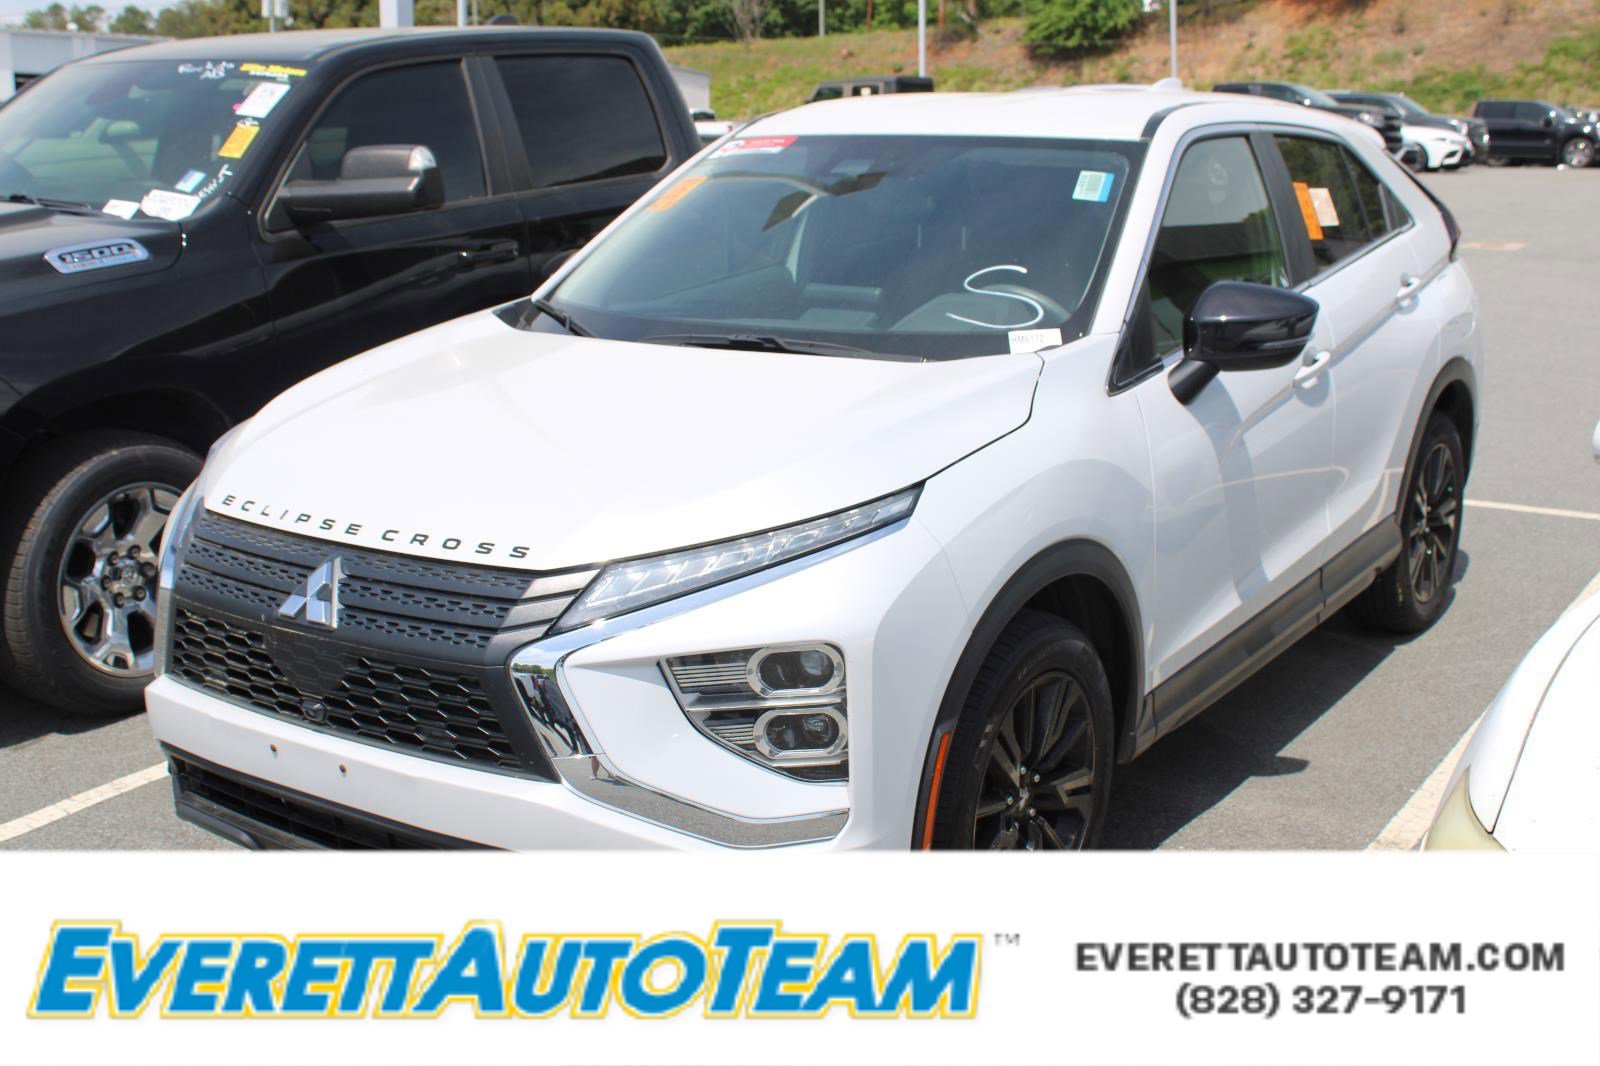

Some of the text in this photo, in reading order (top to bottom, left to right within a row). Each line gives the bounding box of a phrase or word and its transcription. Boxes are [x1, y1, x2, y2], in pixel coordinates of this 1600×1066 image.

[58, 243, 138, 265] 1500
[944, 264, 1045, 329] S
[221, 494, 531, 559] ECLIPSE CROSS
